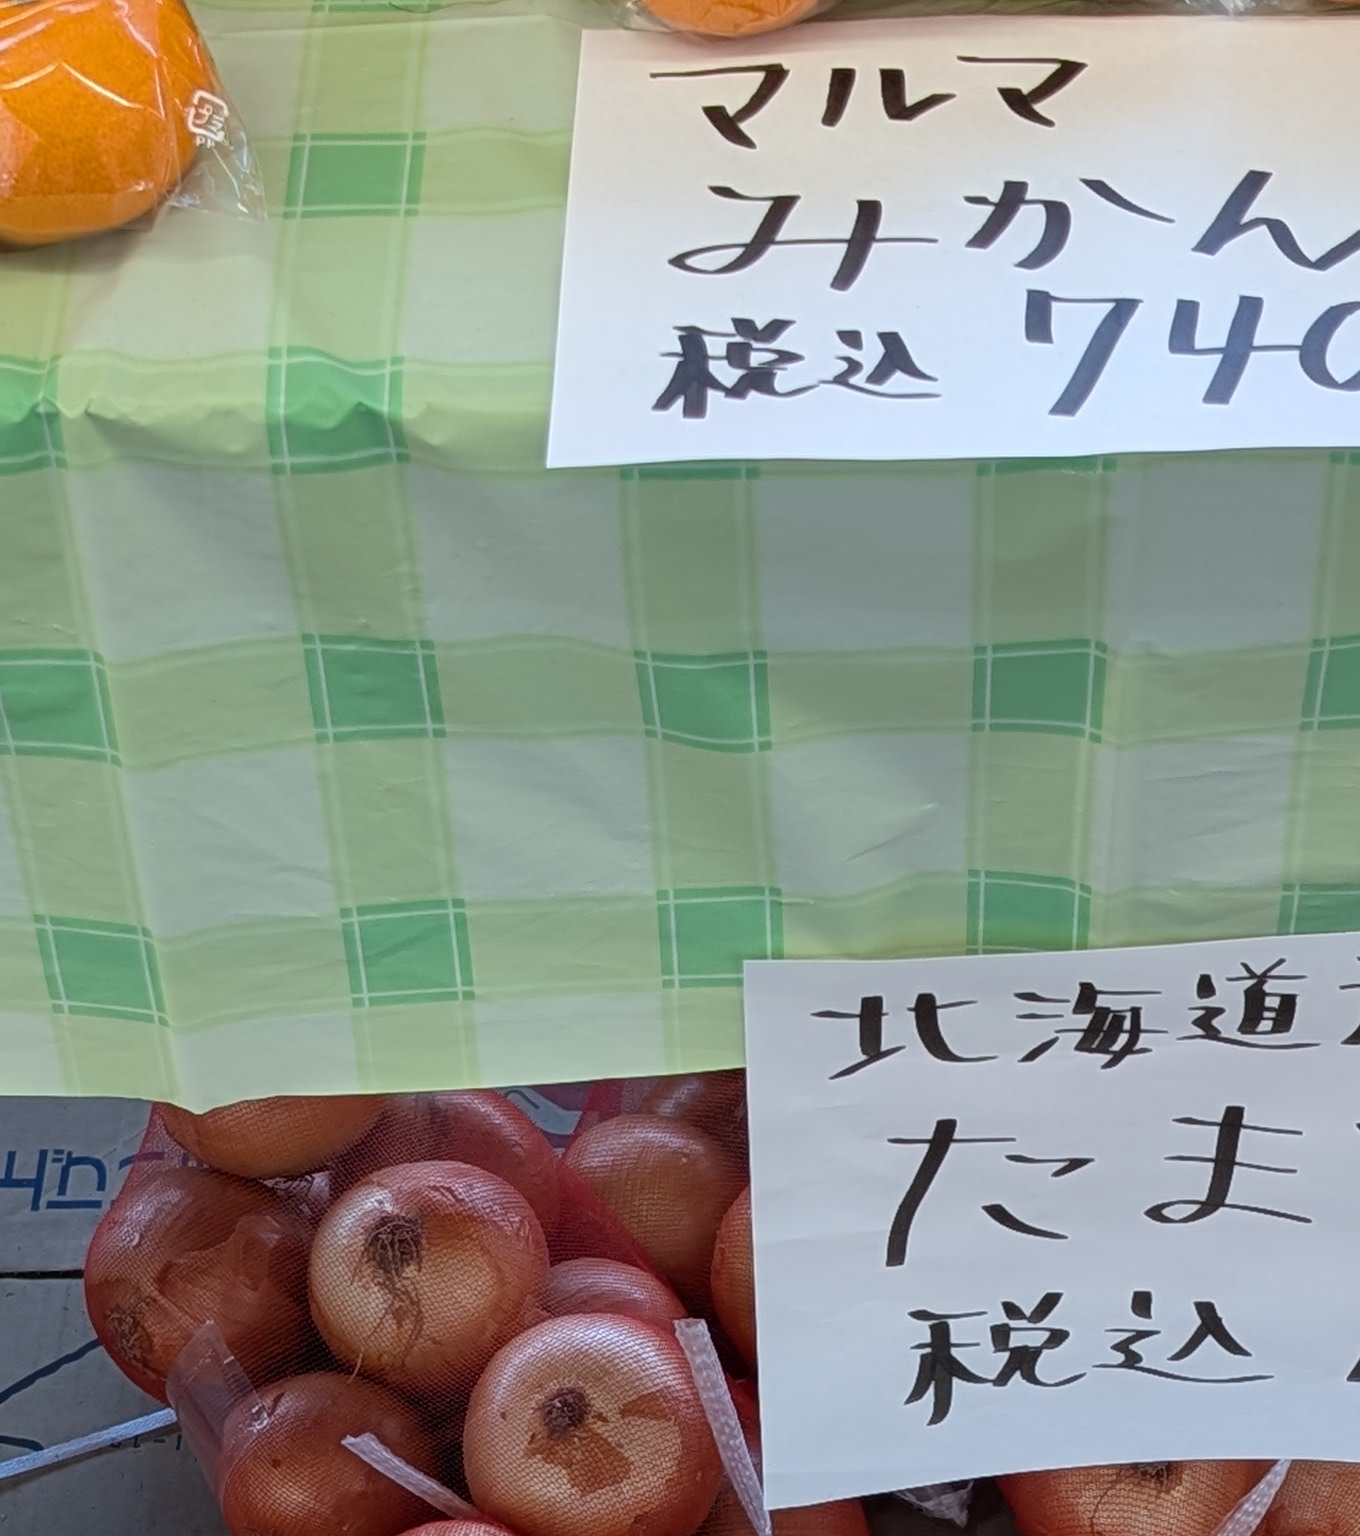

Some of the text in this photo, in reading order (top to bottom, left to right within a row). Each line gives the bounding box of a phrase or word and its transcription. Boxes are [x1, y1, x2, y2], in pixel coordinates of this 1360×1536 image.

[650, 56, 1087, 149] マルマ
[652, 317, 942, 419] 税込
[904, 1290, 1274, 1426] 税込
